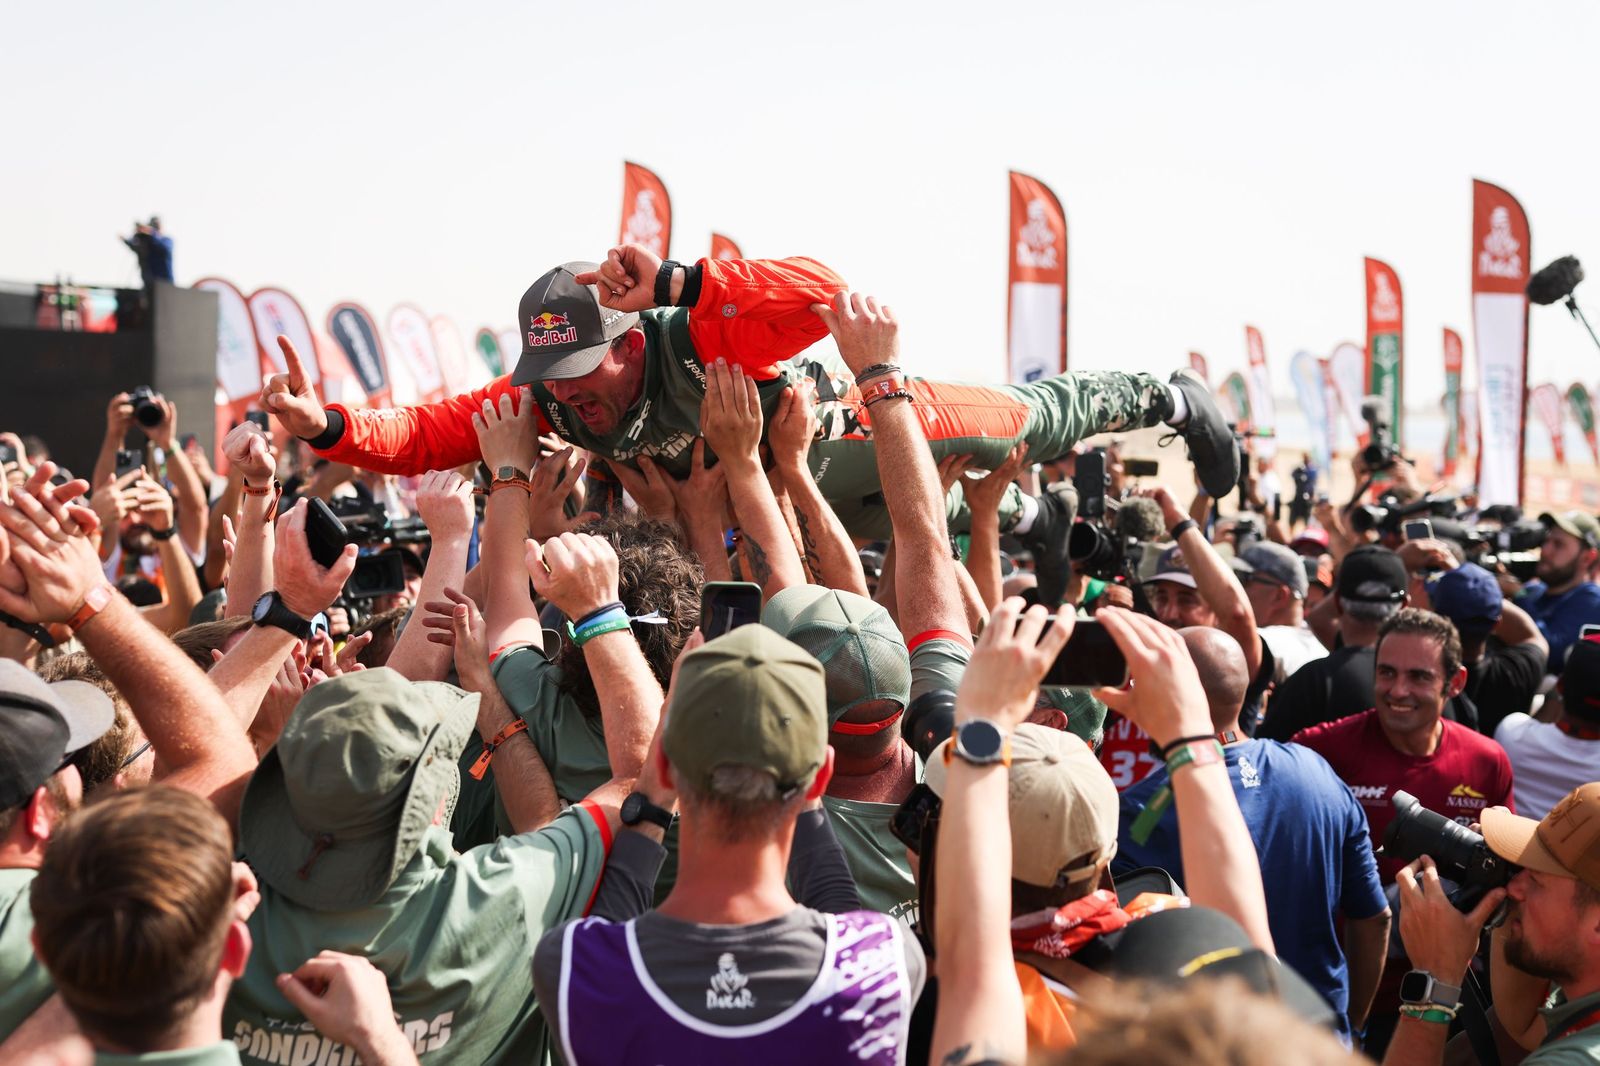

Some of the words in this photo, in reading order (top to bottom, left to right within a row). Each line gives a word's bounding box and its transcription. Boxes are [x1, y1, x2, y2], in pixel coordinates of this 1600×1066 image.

[528, 331, 549, 347] Red
[551, 327, 578, 345] Bull
[547, 402, 570, 436] Sabelt
